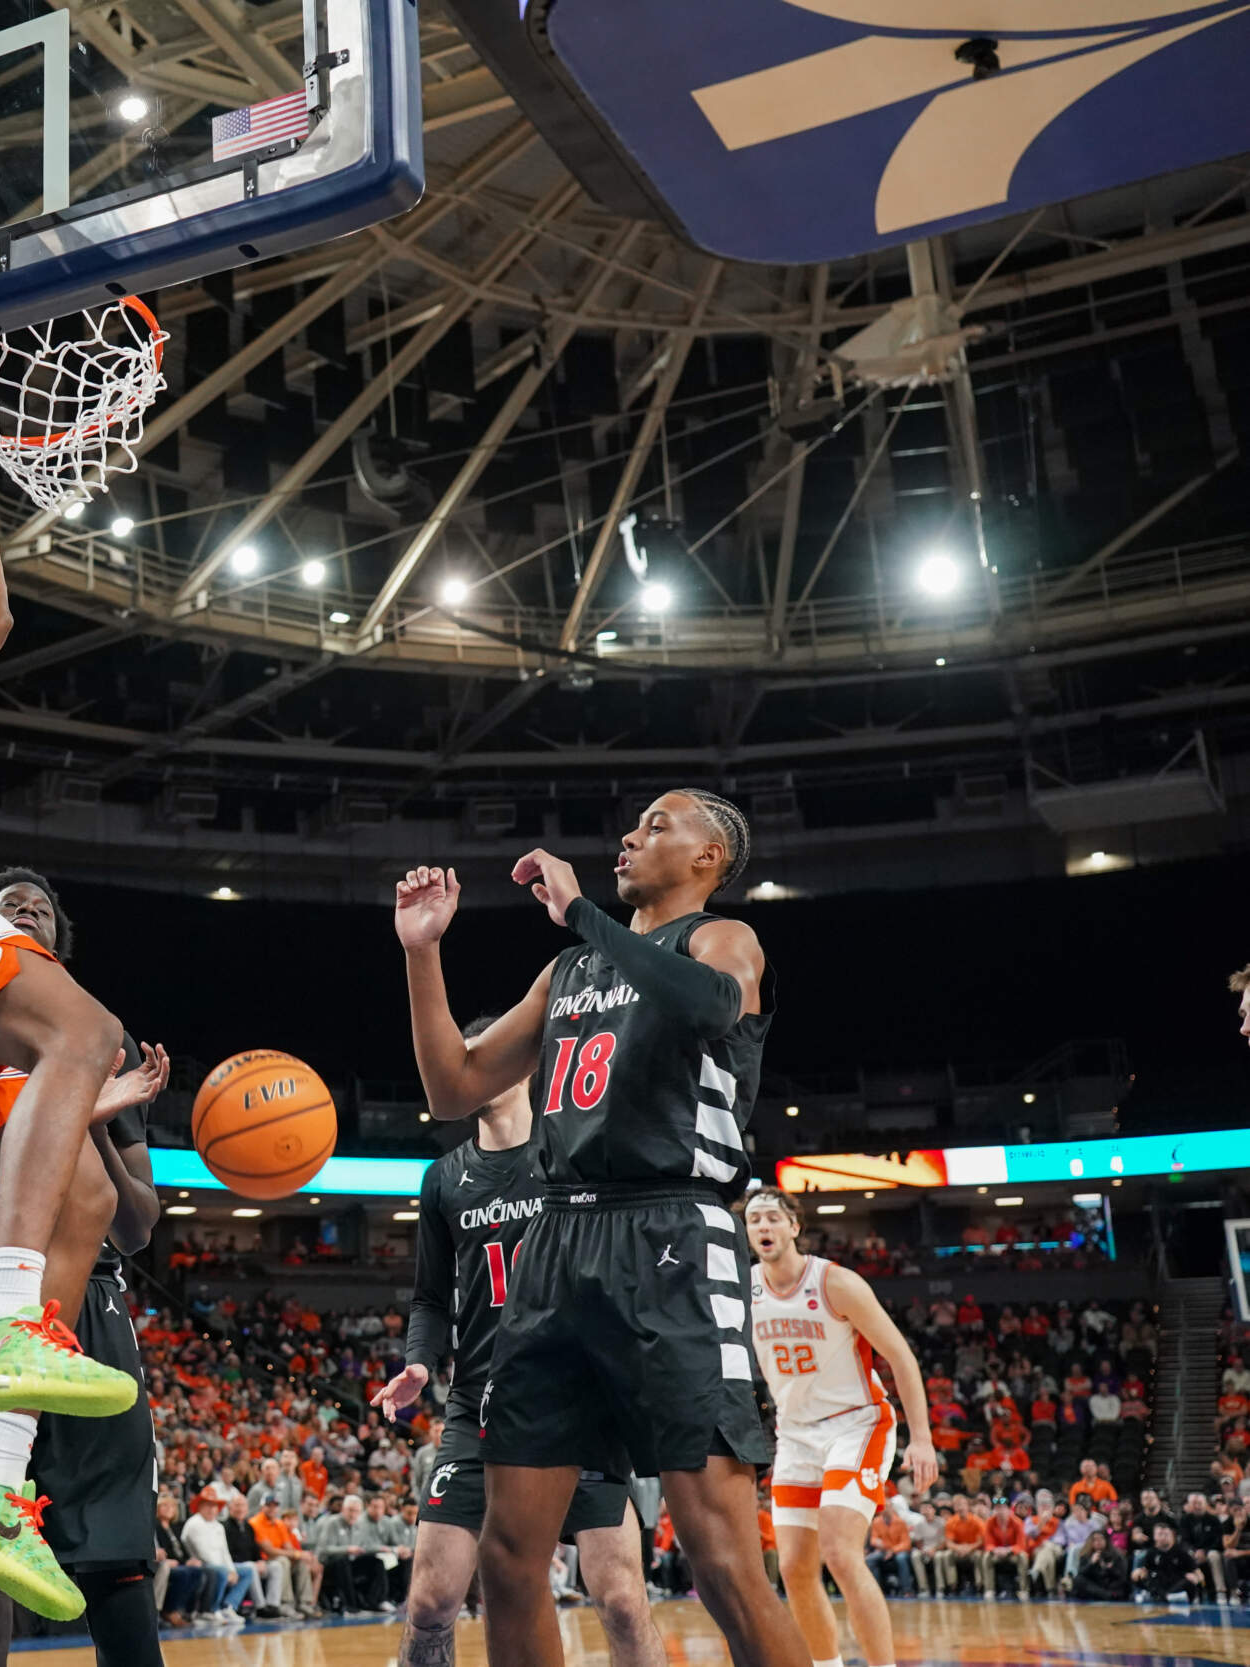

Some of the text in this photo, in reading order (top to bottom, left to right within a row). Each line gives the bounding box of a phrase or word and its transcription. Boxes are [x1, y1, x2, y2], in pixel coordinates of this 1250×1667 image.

[544, 1032, 617, 1115] 18
[460, 1197, 545, 1230] CINCINNA
[483, 1241, 524, 1307] 1
[755, 1318, 826, 1341] CLEMSON
[772, 1343, 818, 1375] 22
